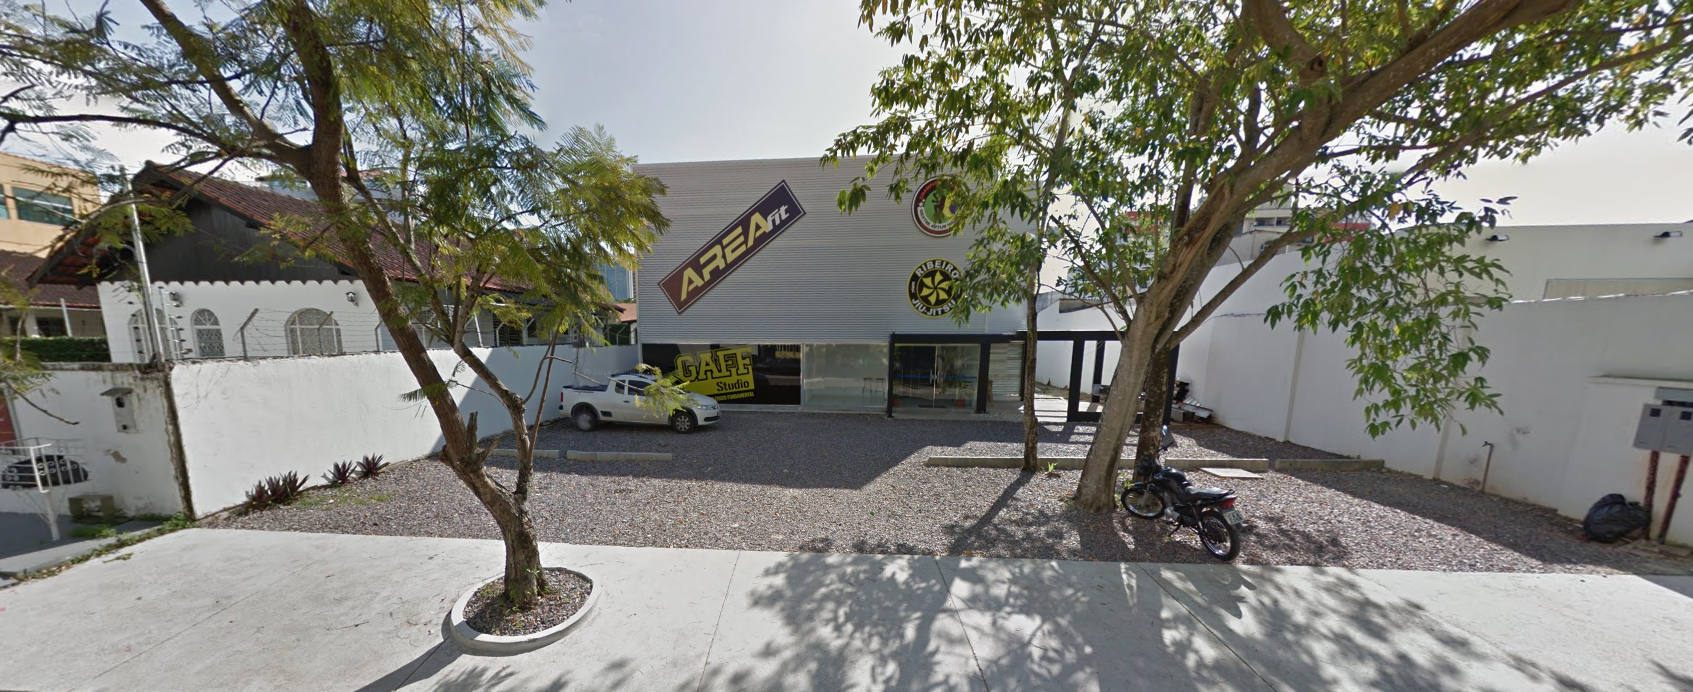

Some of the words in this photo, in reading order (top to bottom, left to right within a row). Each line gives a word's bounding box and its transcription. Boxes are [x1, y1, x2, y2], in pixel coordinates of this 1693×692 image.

[680, 211, 771, 302] AREA
[766, 204, 790, 231] fit
[915, 260, 960, 279] RIBEIRO
[675, 346, 752, 382] GAFF
[716, 379, 750, 392] Studio
